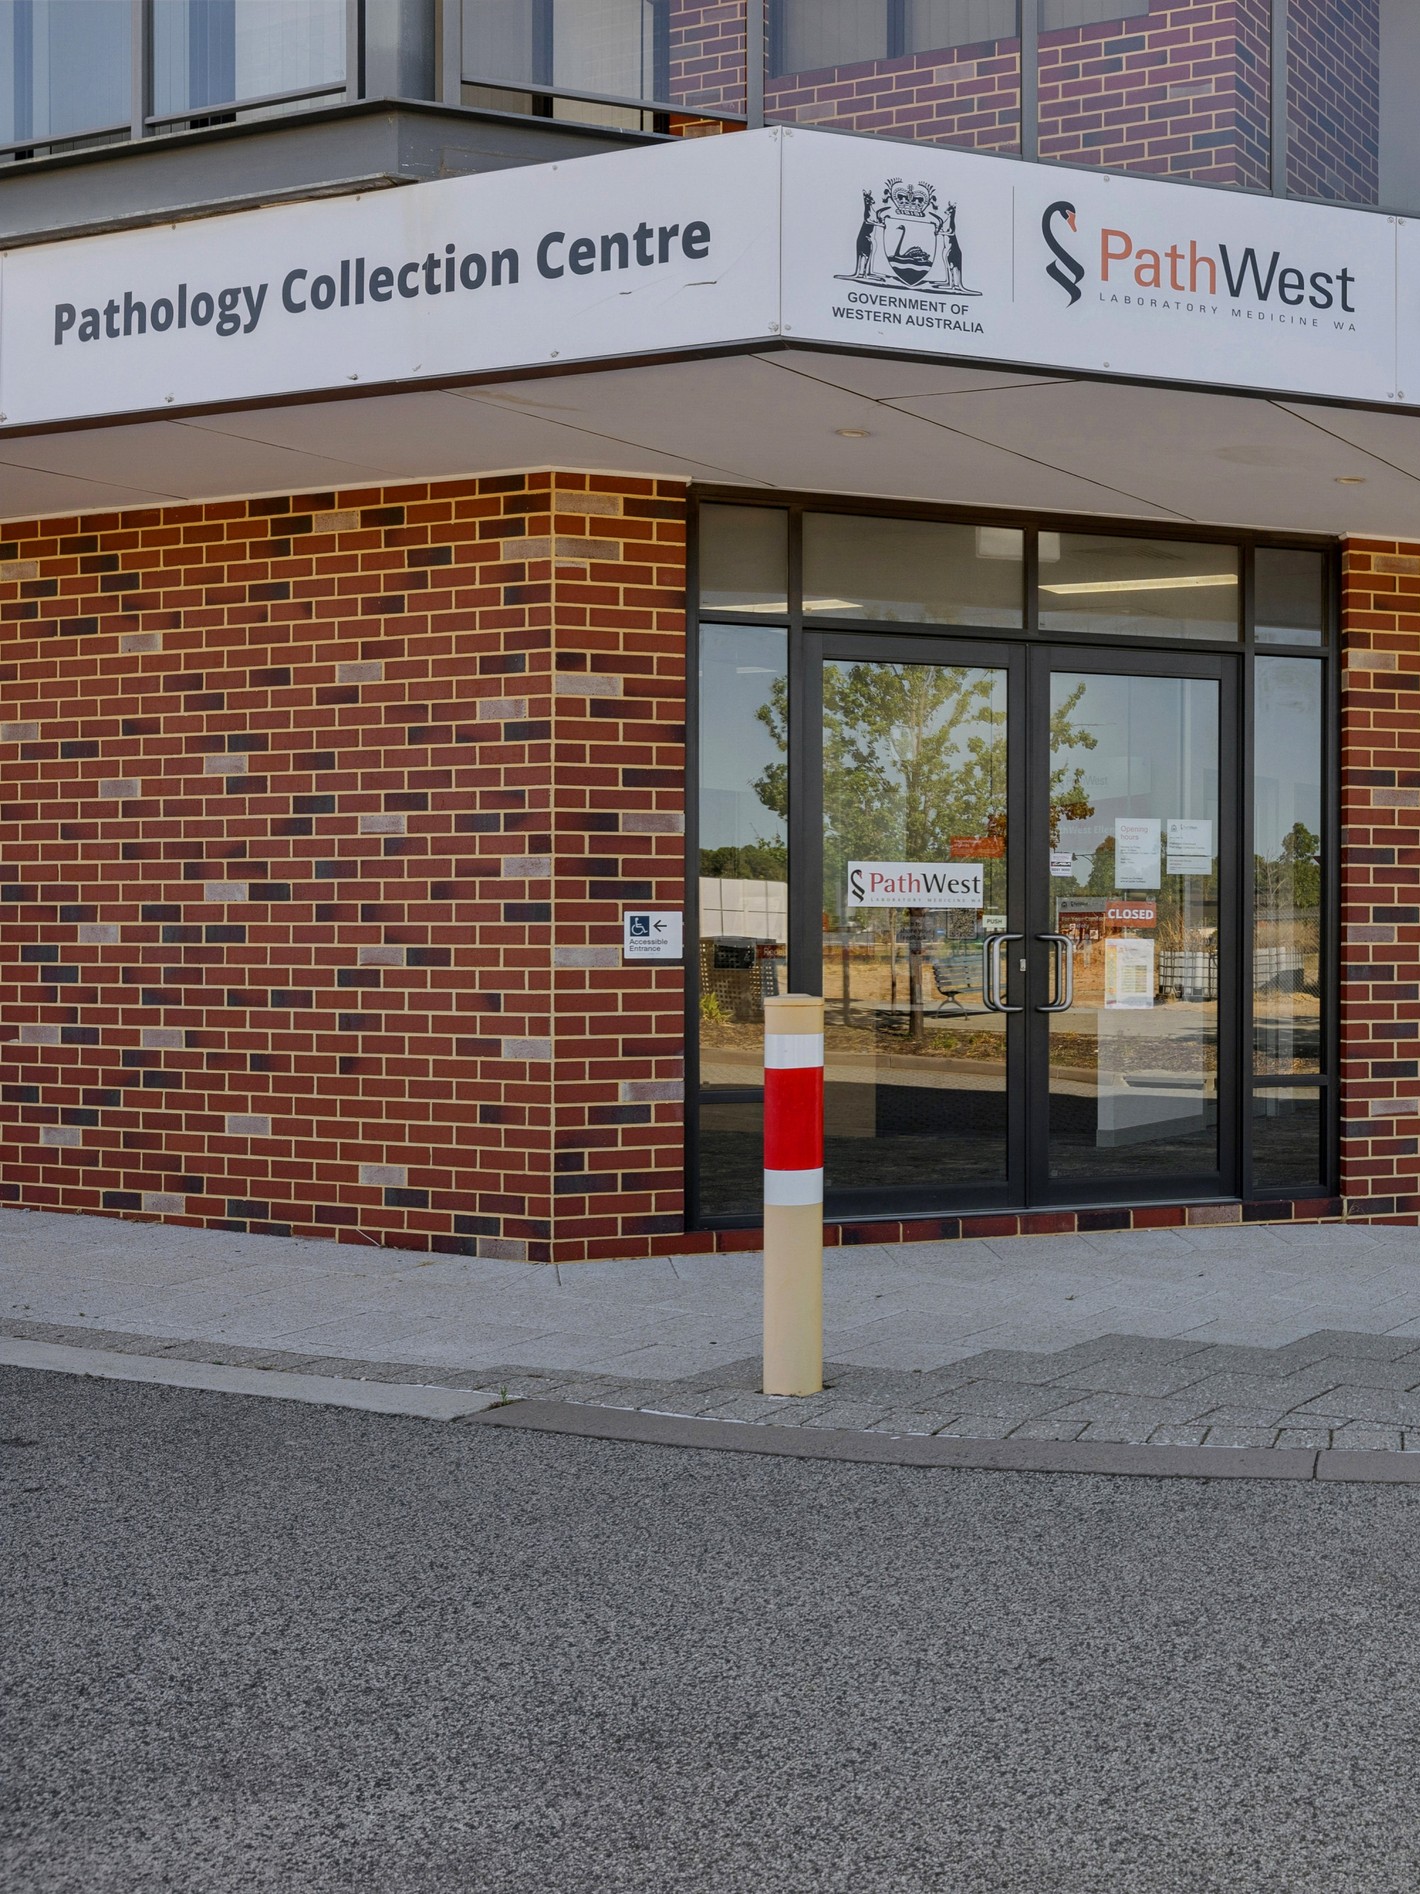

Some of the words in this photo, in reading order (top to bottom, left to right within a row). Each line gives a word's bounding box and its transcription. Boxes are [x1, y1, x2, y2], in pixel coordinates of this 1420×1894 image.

[54, 283, 268, 345] Pathology
[281, 243, 519, 314] Collection
[536, 219, 711, 280] Centre
[1100, 227, 1356, 313] PathWest
[847, 292, 946, 312] GOVERNMENT
[950, 303, 970, 316] OF
[1099, 292, 1218, 315] LABORATORY
[1231, 308, 1319, 328] MEDICINE
[1333, 320, 1357, 332] WA
[831, 306, 902, 325] WESTERN
[905, 314, 985, 334] AUSTRALIA
[1120, 825, 1148, 834] Opening
[869, 872, 981, 894] PathWest
[1107, 908, 1154, 920] CLOSED
